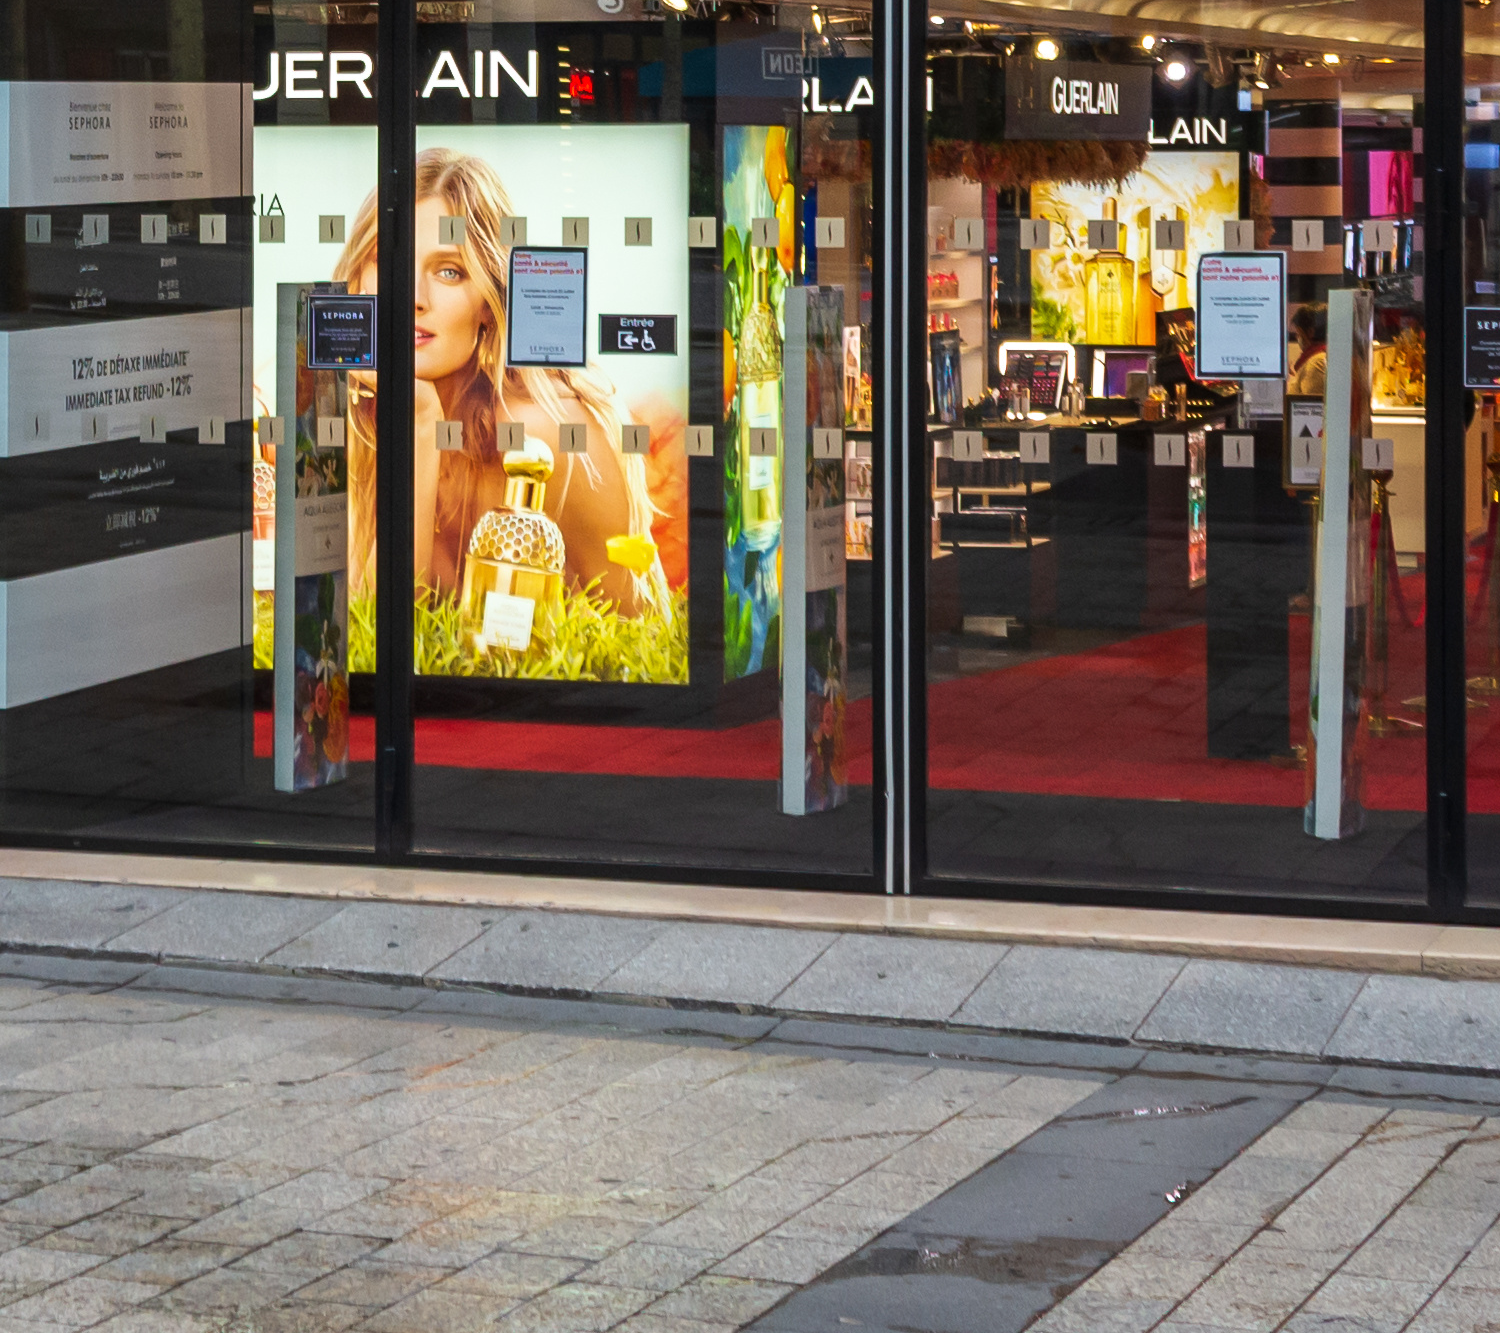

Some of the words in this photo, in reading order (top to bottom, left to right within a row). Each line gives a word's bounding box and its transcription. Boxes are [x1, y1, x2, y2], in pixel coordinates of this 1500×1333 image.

[1052, 76, 1119, 115] GUERLAIN
[69, 116, 111, 130] SEPHORA
[150, 116, 188, 129] SEPHORA
[322, 311, 365, 320] SEPHORA
[619, 316, 655, 328] Entrée
[72, 356, 95, 380] 12%
[96, 360, 108, 377] DE
[109, 354, 141, 376] DÉTAXE
[65, 389, 113, 412] IMMEDIATE
[115, 387, 132, 404] TAX
[132, 383, 165, 403] REFUND
